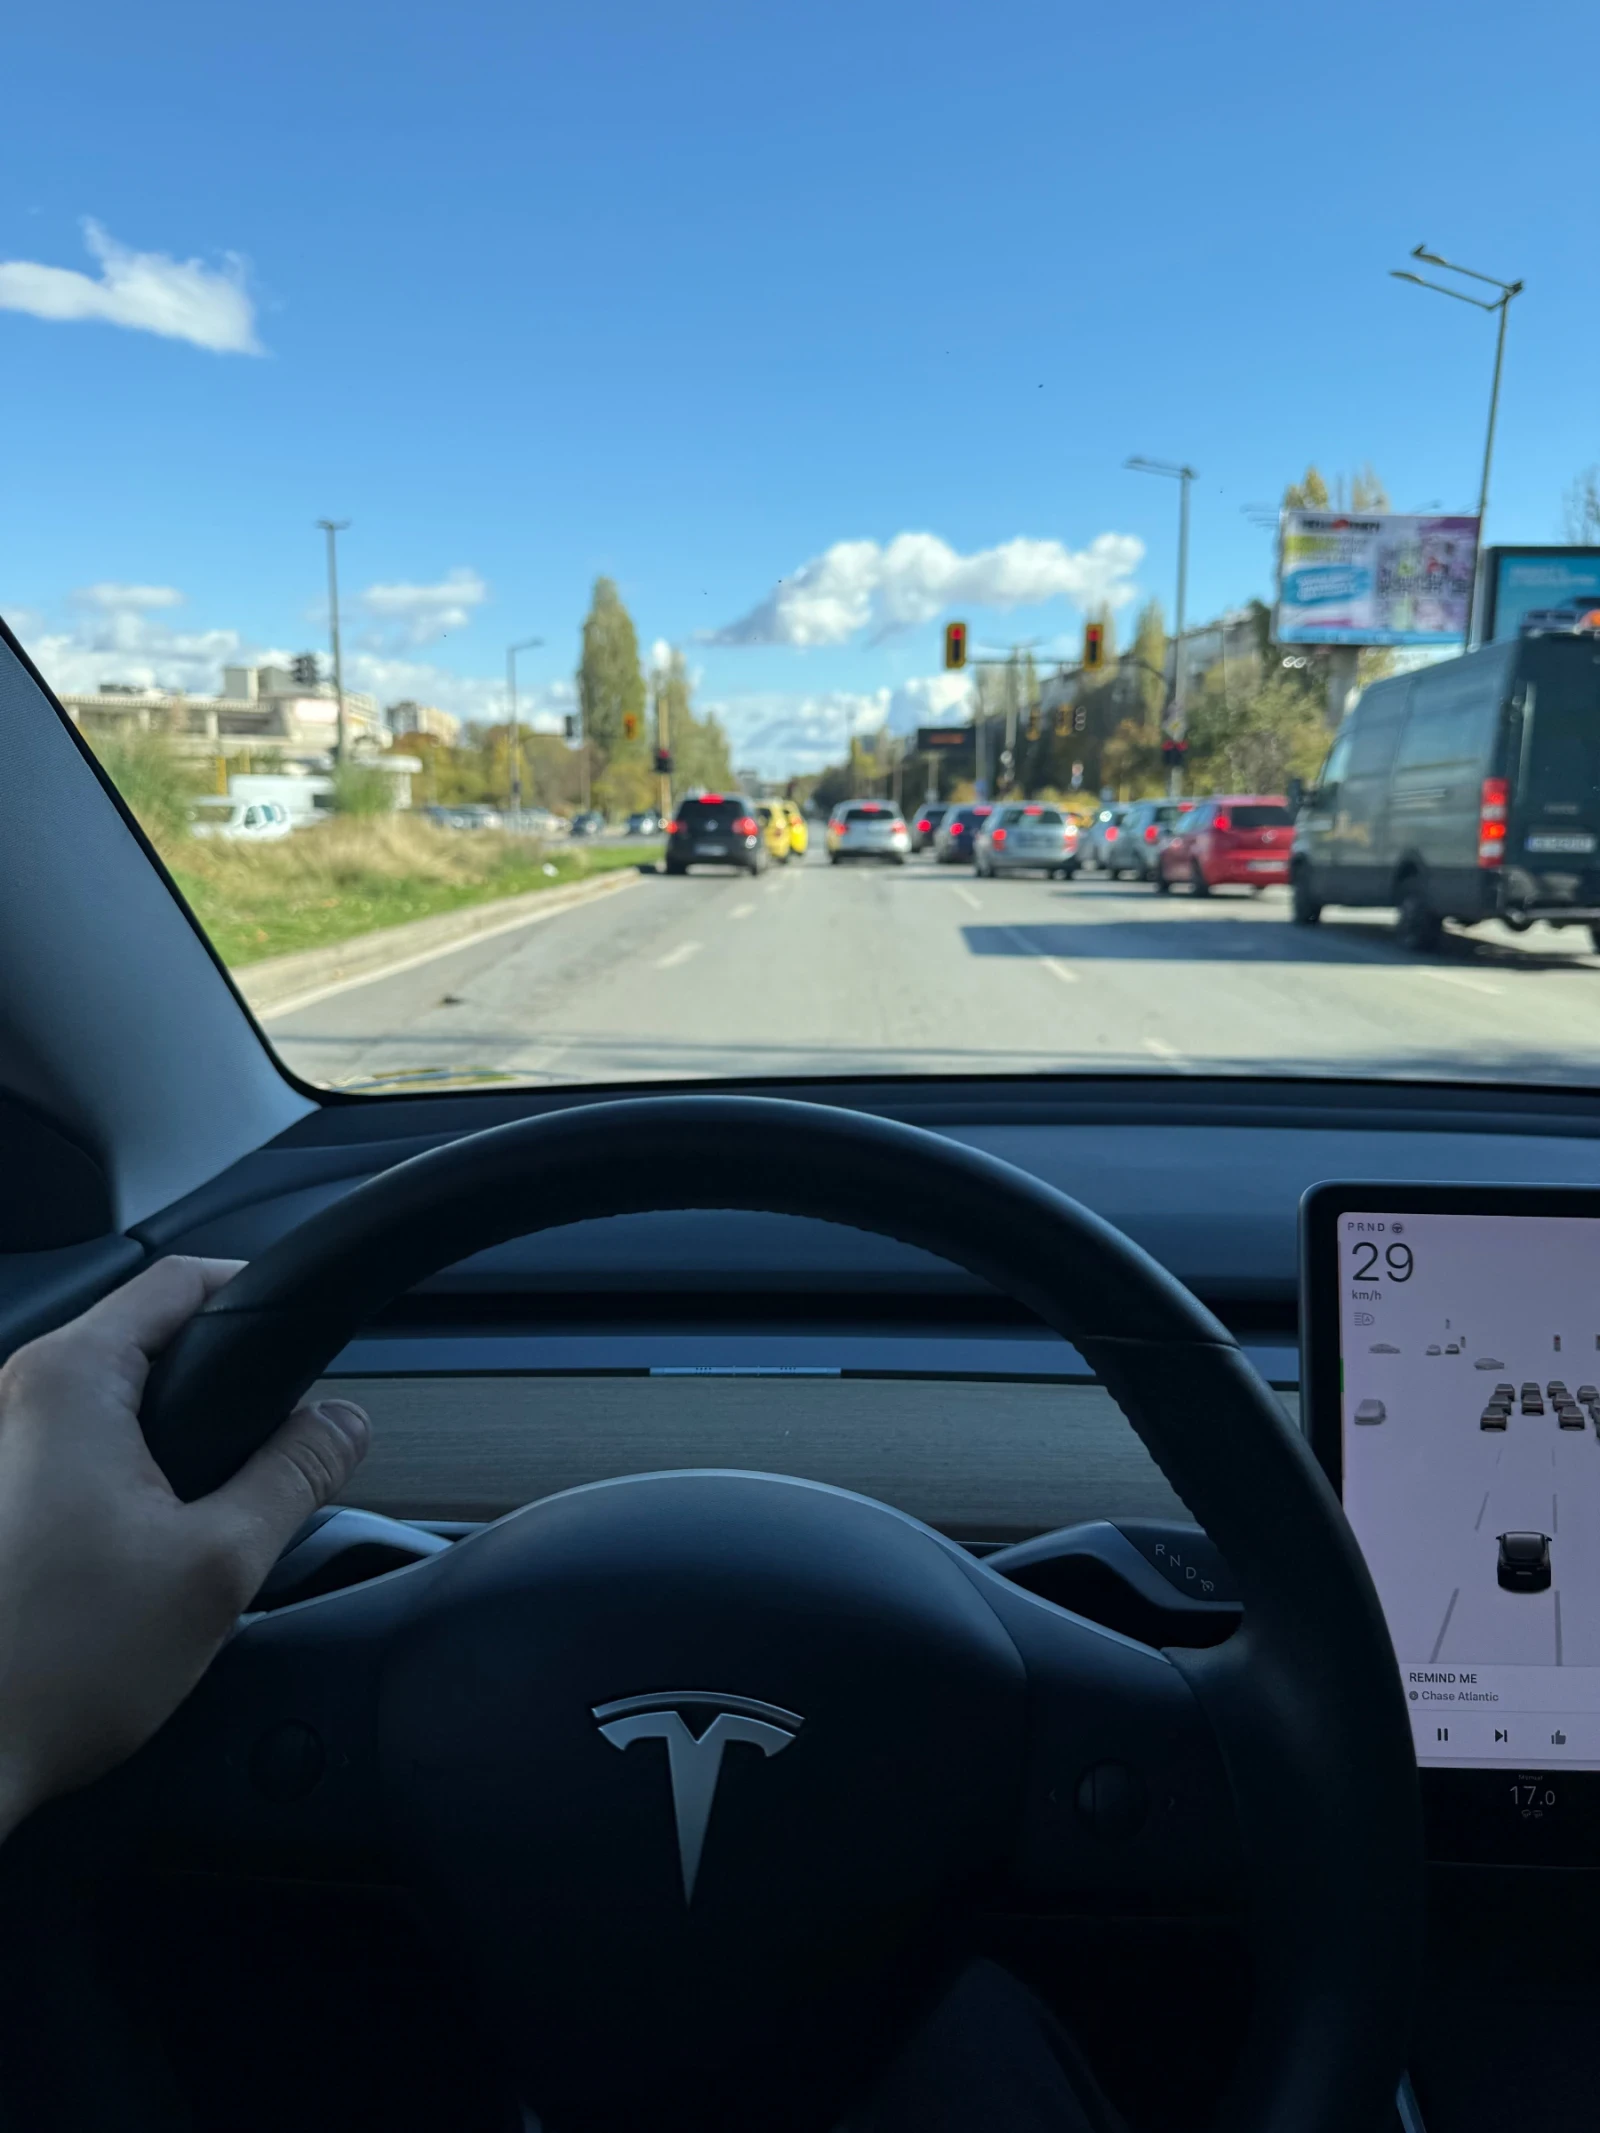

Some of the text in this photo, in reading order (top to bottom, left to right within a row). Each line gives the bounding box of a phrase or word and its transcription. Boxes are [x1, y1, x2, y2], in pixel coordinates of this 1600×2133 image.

[1352, 1241, 1414, 1283] 29
[1351, 1289, 1382, 1301] km/h
[1155, 1544, 1165, 1555] R
[1170, 1554, 1181, 1567] N
[1185, 1566, 1197, 1579] D
[1409, 1672, 1477, 1684] REMIND ME
[1421, 1690, 1499, 1702] Chase Atlantic
[1509, 1785, 1556, 1806] 17.0
